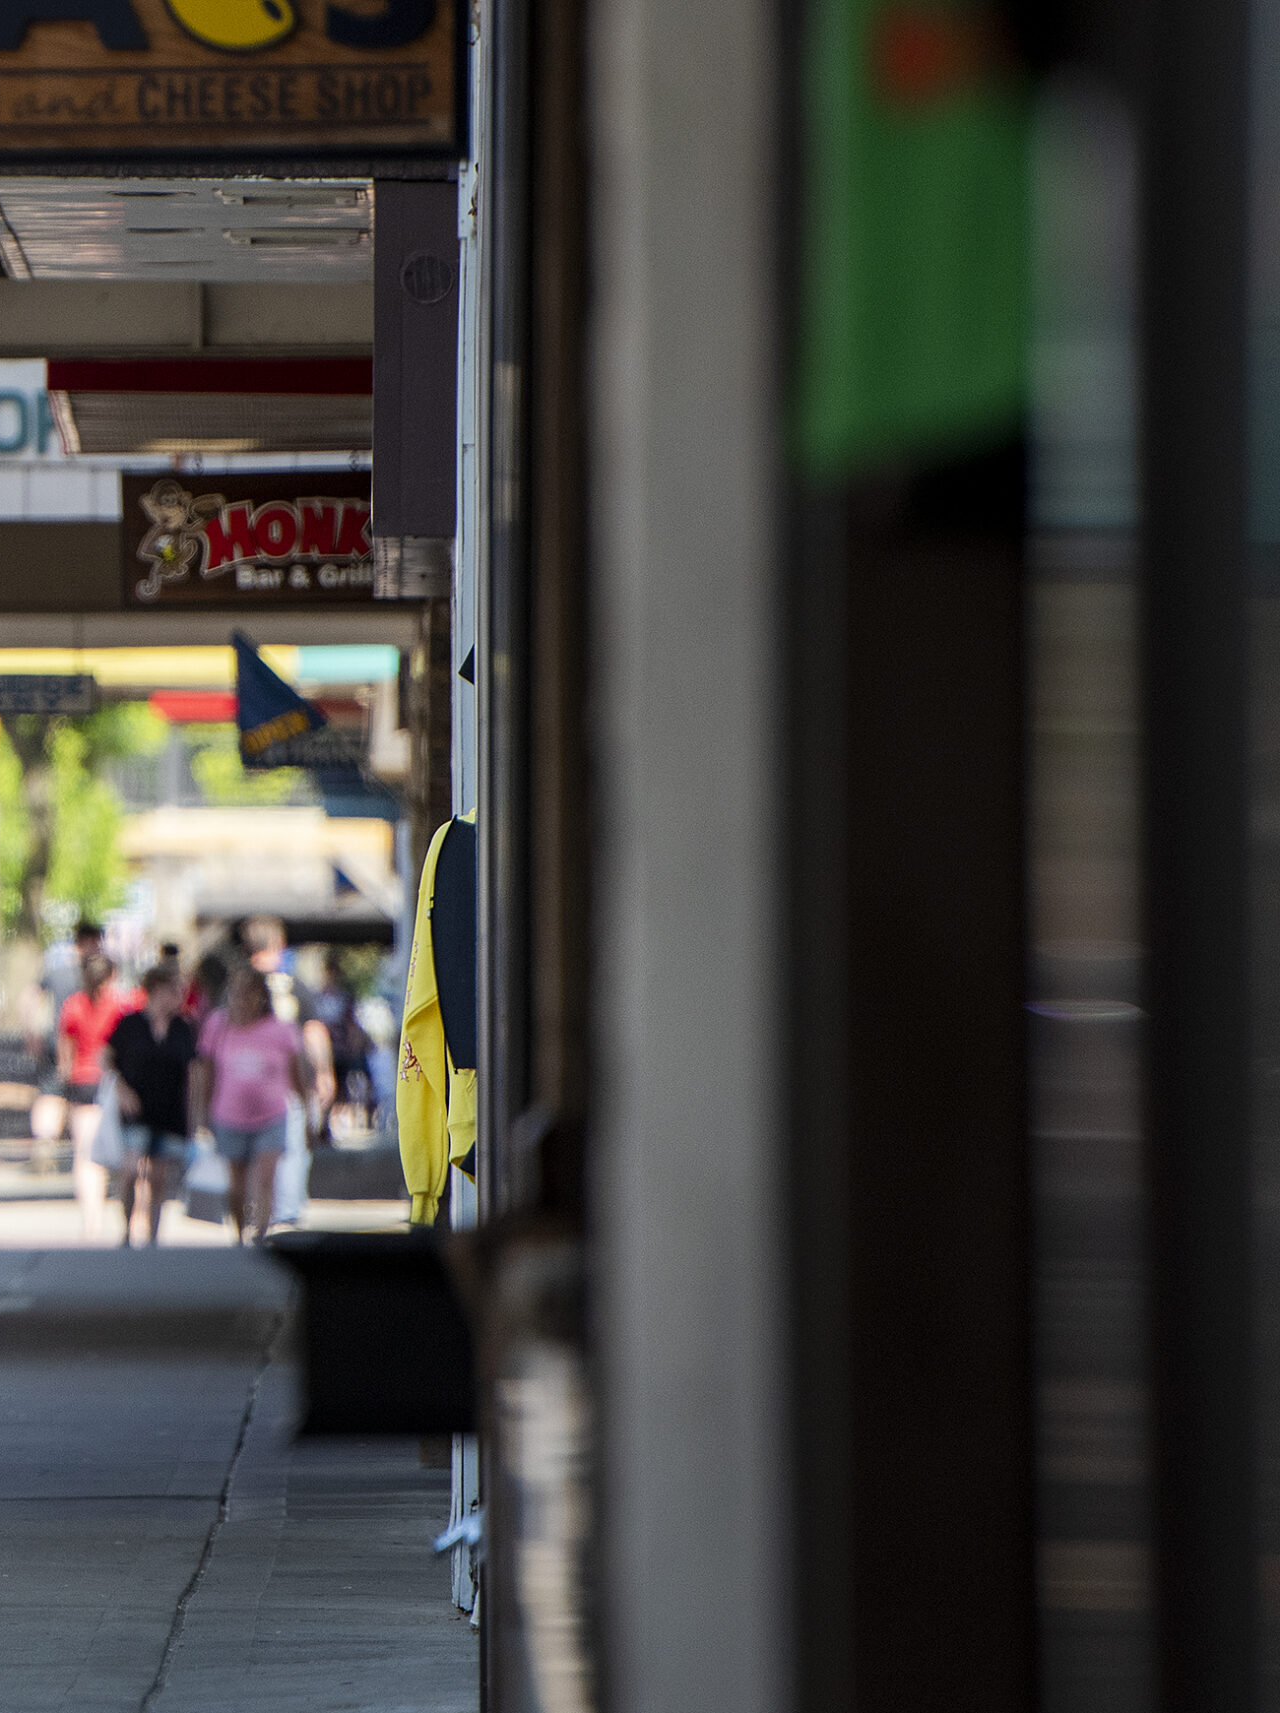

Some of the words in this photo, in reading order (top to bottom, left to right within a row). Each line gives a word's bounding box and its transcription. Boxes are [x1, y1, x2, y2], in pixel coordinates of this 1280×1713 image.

[136, 73, 298, 122] CHEESE
[319, 71, 433, 121] SHOP
[236, 564, 283, 590] Bar
[288, 563, 311, 590] &
